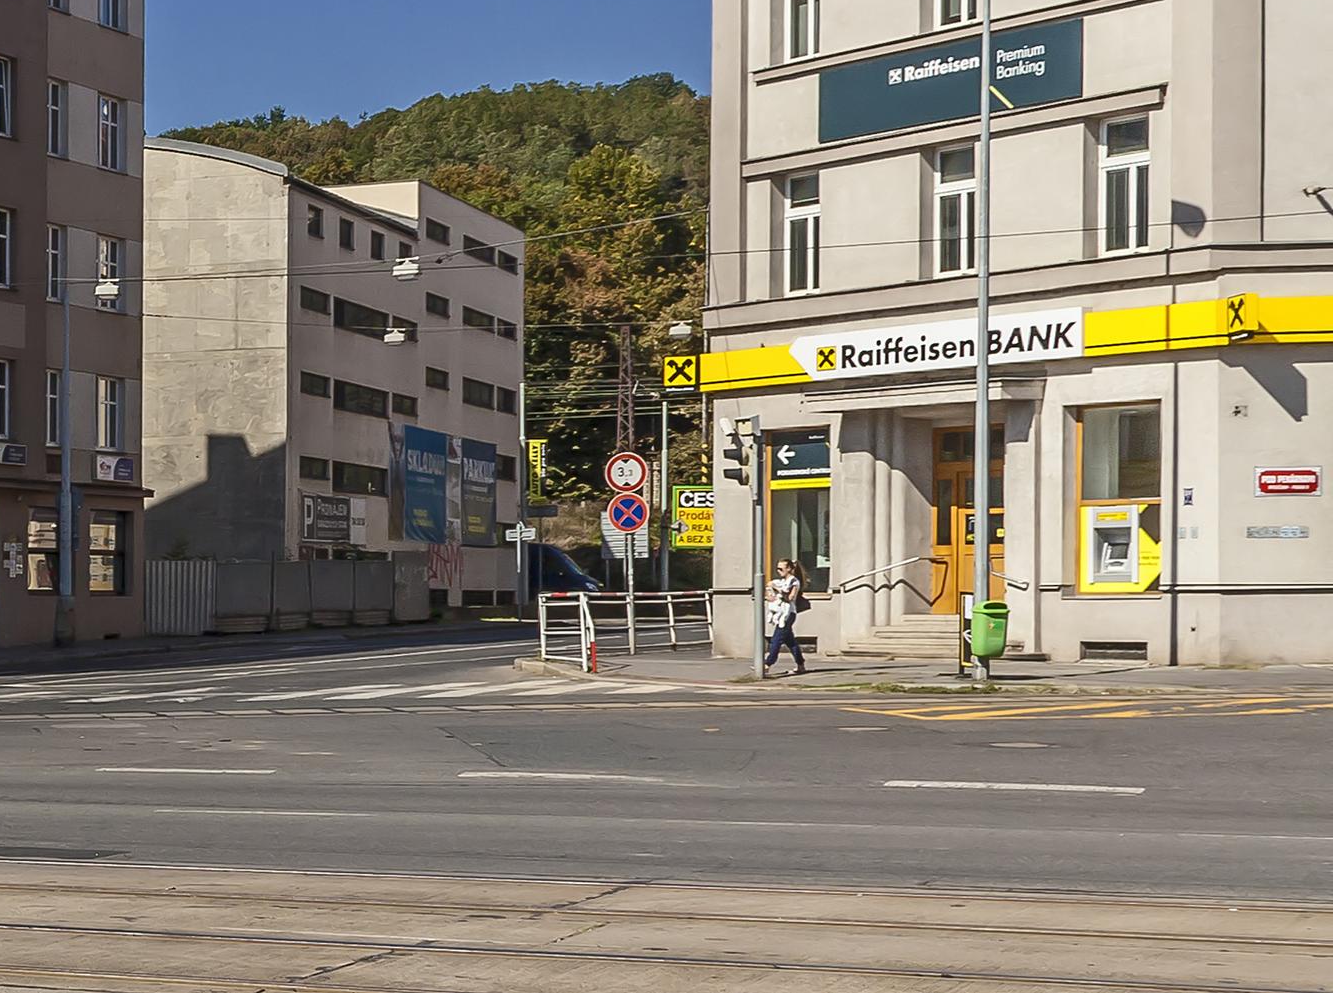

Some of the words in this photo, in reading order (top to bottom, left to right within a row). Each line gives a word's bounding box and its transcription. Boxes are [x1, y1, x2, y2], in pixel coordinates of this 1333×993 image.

[996, 44, 1045, 63] Premium
[904, 56, 980, 83] Raiffeisen
[996, 59, 1046, 80] Banking
[841, 335, 975, 369] Raiffeisen
